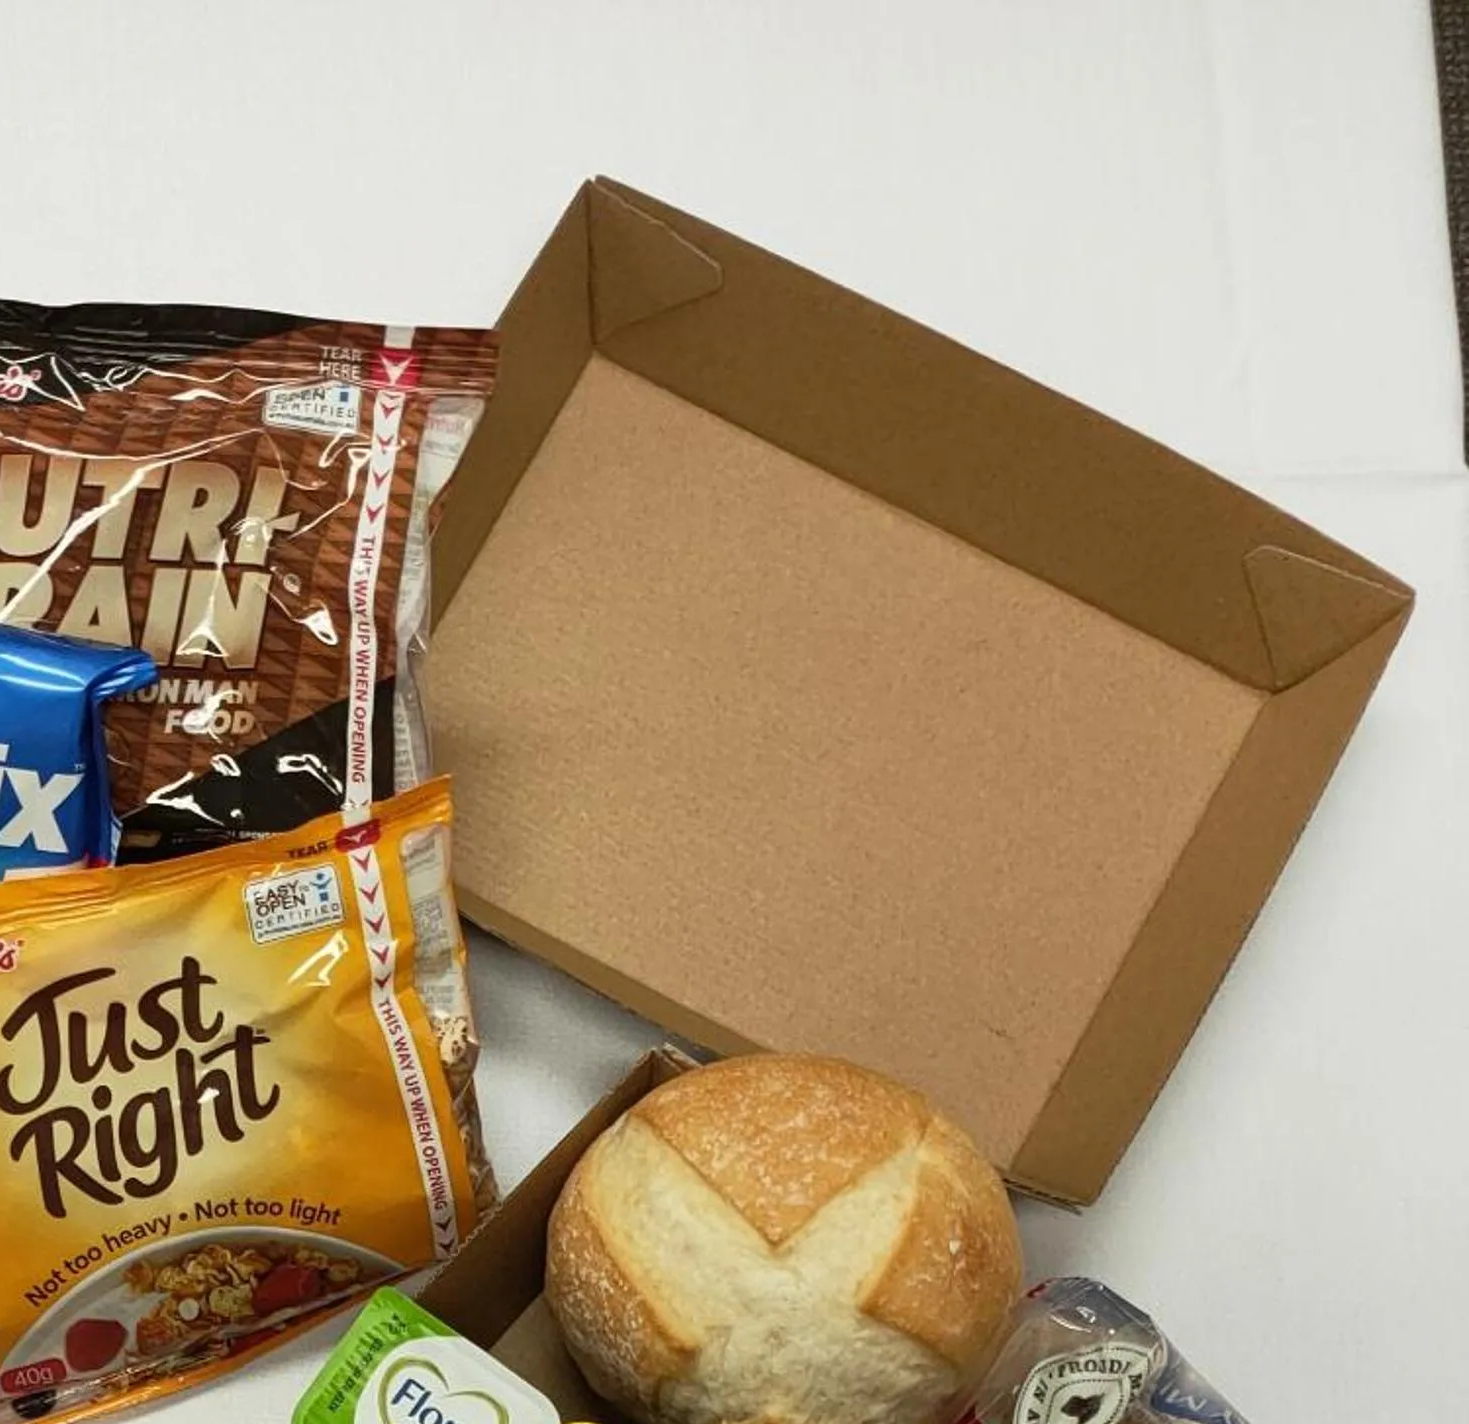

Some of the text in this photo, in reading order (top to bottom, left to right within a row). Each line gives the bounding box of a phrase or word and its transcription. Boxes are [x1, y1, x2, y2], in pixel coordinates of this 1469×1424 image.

[350, 646, 372, 785] WHEN OPENING
[9, 1025, 279, 1218] Right
[23, 1198, 340, 1307] Not too heavy Not too light
[13, 1366, 54, 1387] 40g
